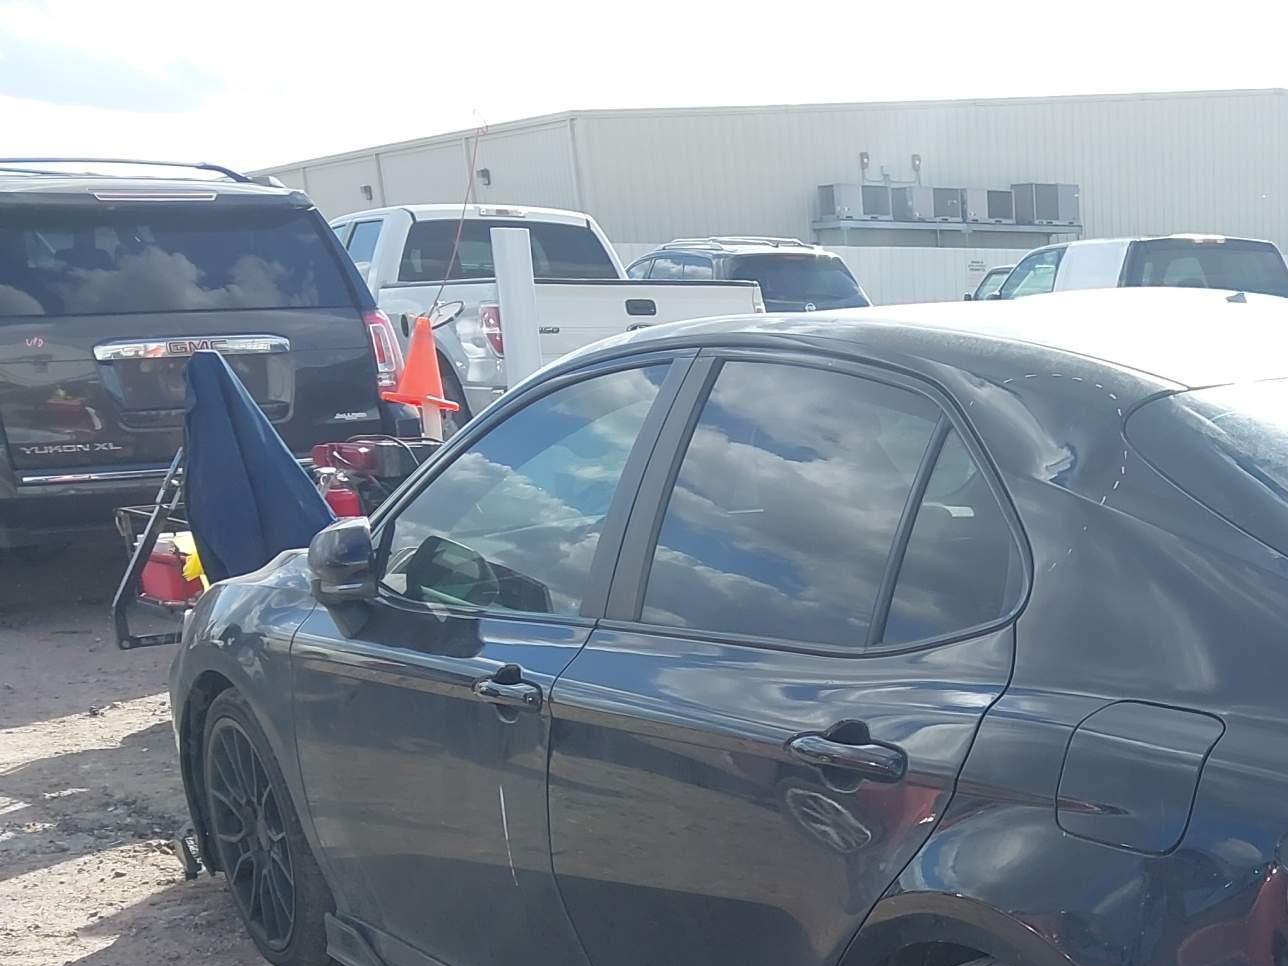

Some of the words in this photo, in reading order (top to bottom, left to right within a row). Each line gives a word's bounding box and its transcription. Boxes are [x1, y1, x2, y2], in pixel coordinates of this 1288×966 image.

[167, 340, 228, 354] GMC
[19, 444, 90, 455] YUKON
[93, 442, 122, 451] XL
